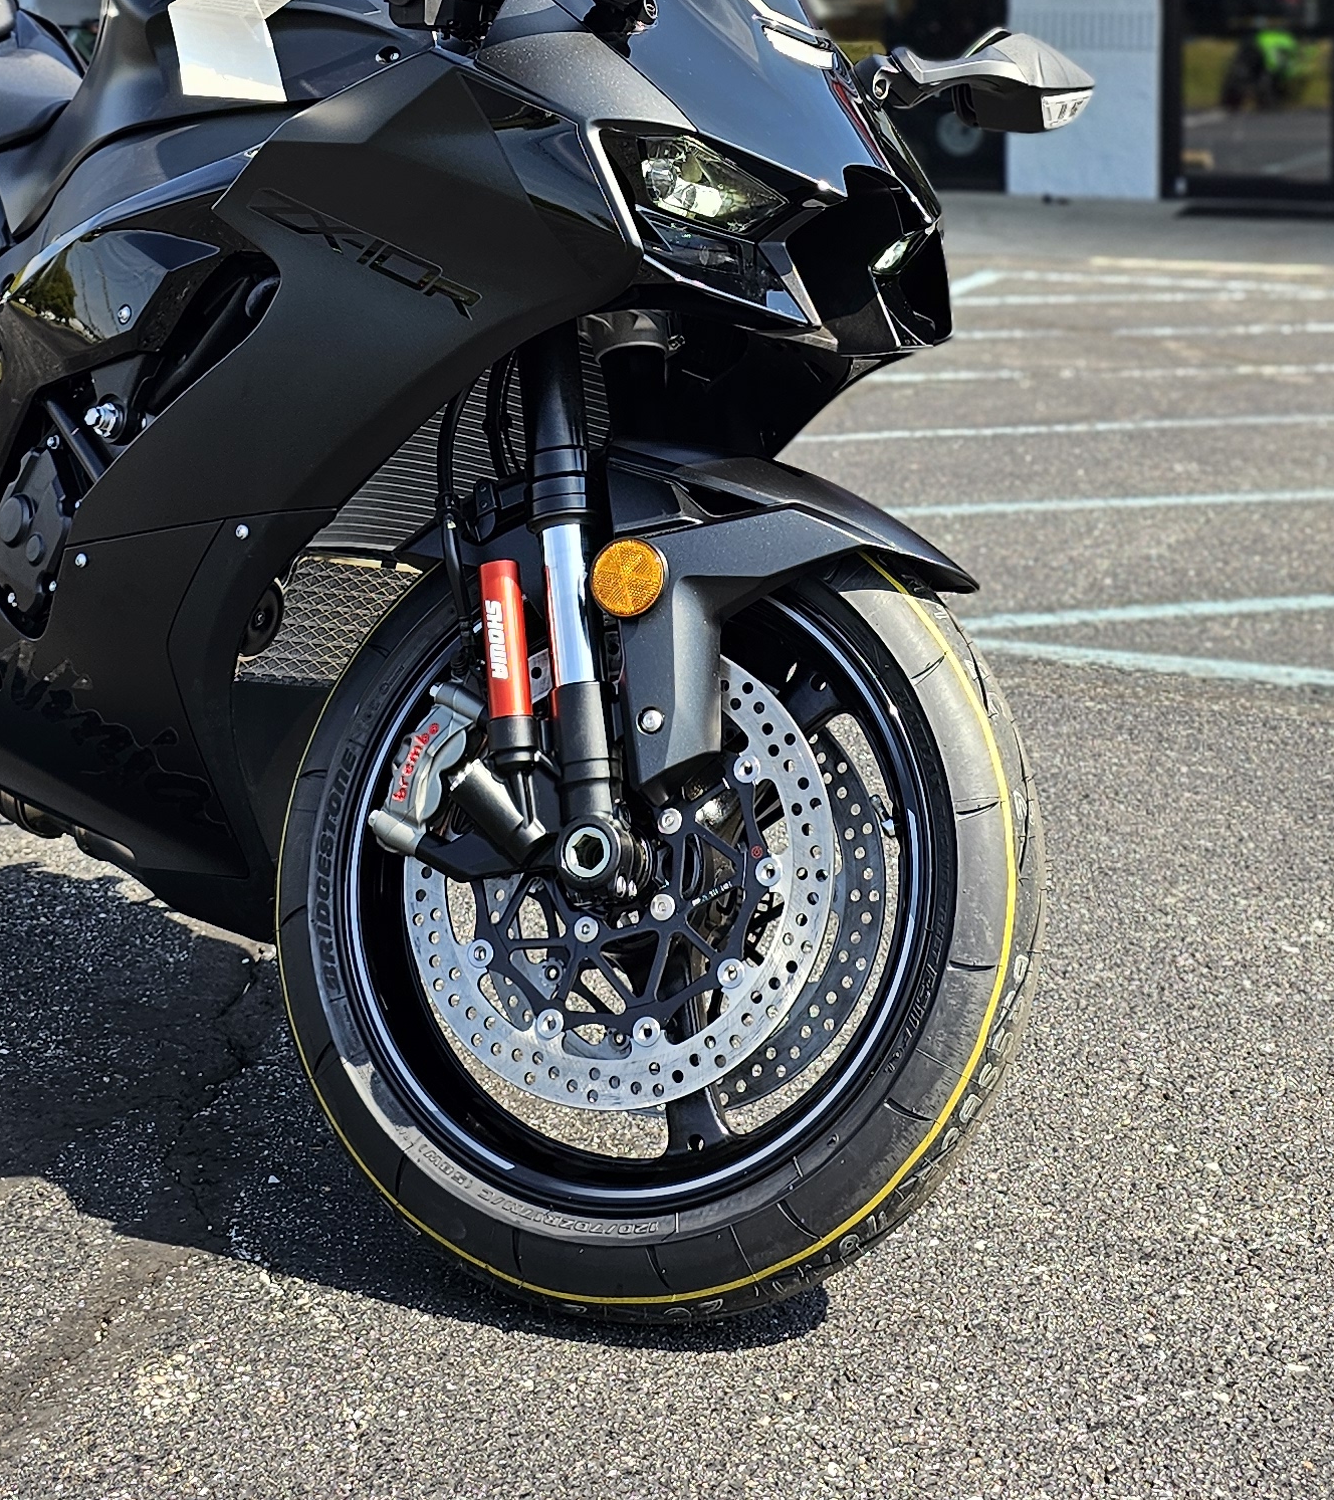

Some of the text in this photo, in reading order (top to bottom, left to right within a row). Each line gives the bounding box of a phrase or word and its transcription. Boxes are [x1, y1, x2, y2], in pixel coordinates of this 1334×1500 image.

[247, 188, 482, 320] ZX-10R
[485, 599, 508, 679] SHOWA
[392, 722, 440, 802] brembo
[316, 747, 358, 992] BRIDGESTONE
